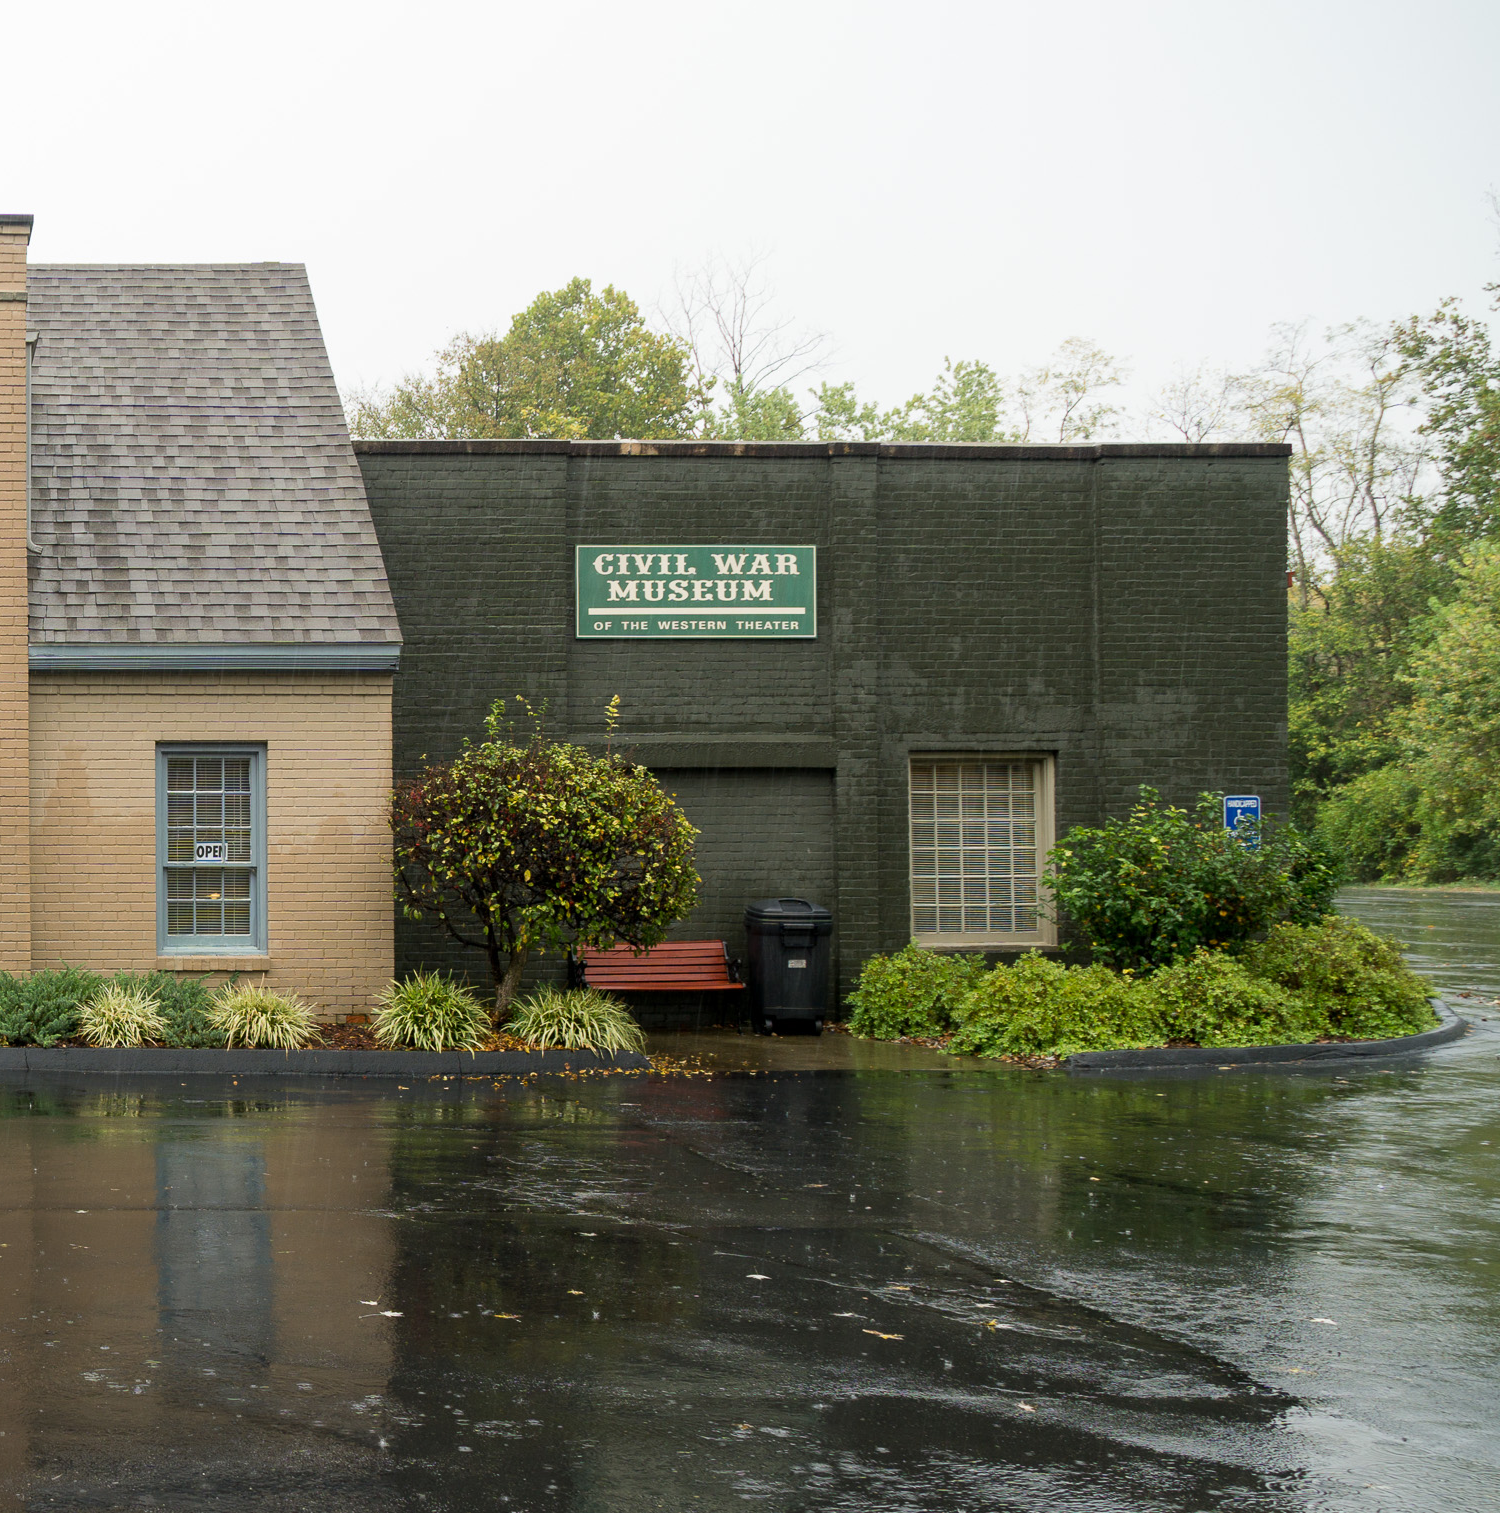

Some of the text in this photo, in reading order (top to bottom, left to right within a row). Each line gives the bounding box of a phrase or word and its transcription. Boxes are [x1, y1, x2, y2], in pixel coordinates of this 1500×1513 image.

[592, 553, 801, 575] CIVIL WAR
[606, 579, 774, 602] MUSEUM
[593, 620, 800, 631] OF THE WESTERN THEATER
[196, 845, 227, 858] OPEN
